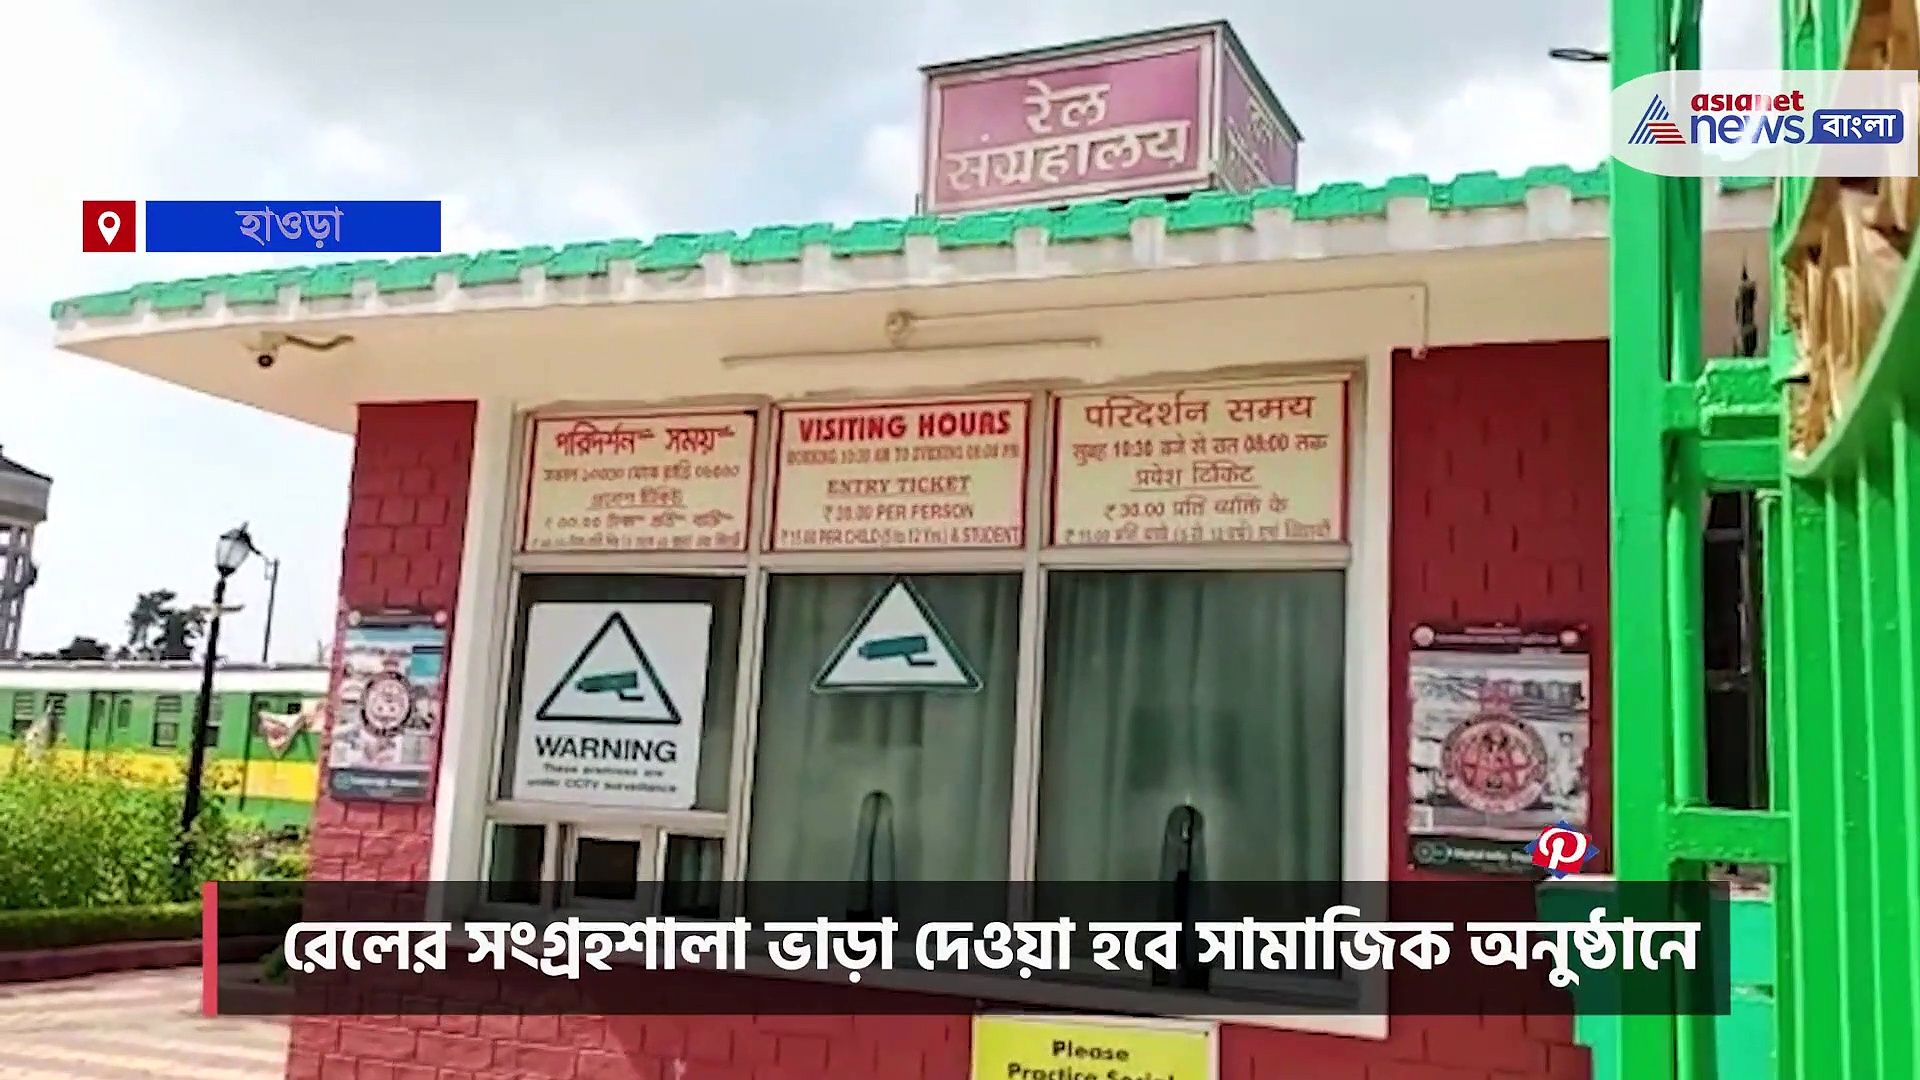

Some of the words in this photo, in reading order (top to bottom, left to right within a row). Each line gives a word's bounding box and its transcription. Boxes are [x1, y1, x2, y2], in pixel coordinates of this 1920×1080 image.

[1024, 78, 1111, 133] रेल
[945, 119, 1192, 192] संग्रहालय
[1084, 389, 1211, 429] परिदर्शन
[1225, 394, 1317, 424] समय
[799, 415, 906, 443] VISITING
[918, 409, 1011, 438] HOURS
[826, 477, 891, 494] ENTRY
[899, 474, 971, 493] TICKET
[876, 503, 907, 521] PER
[535, 735, 677, 763] WARNING
[1052, 1039, 1129, 1062] Please
